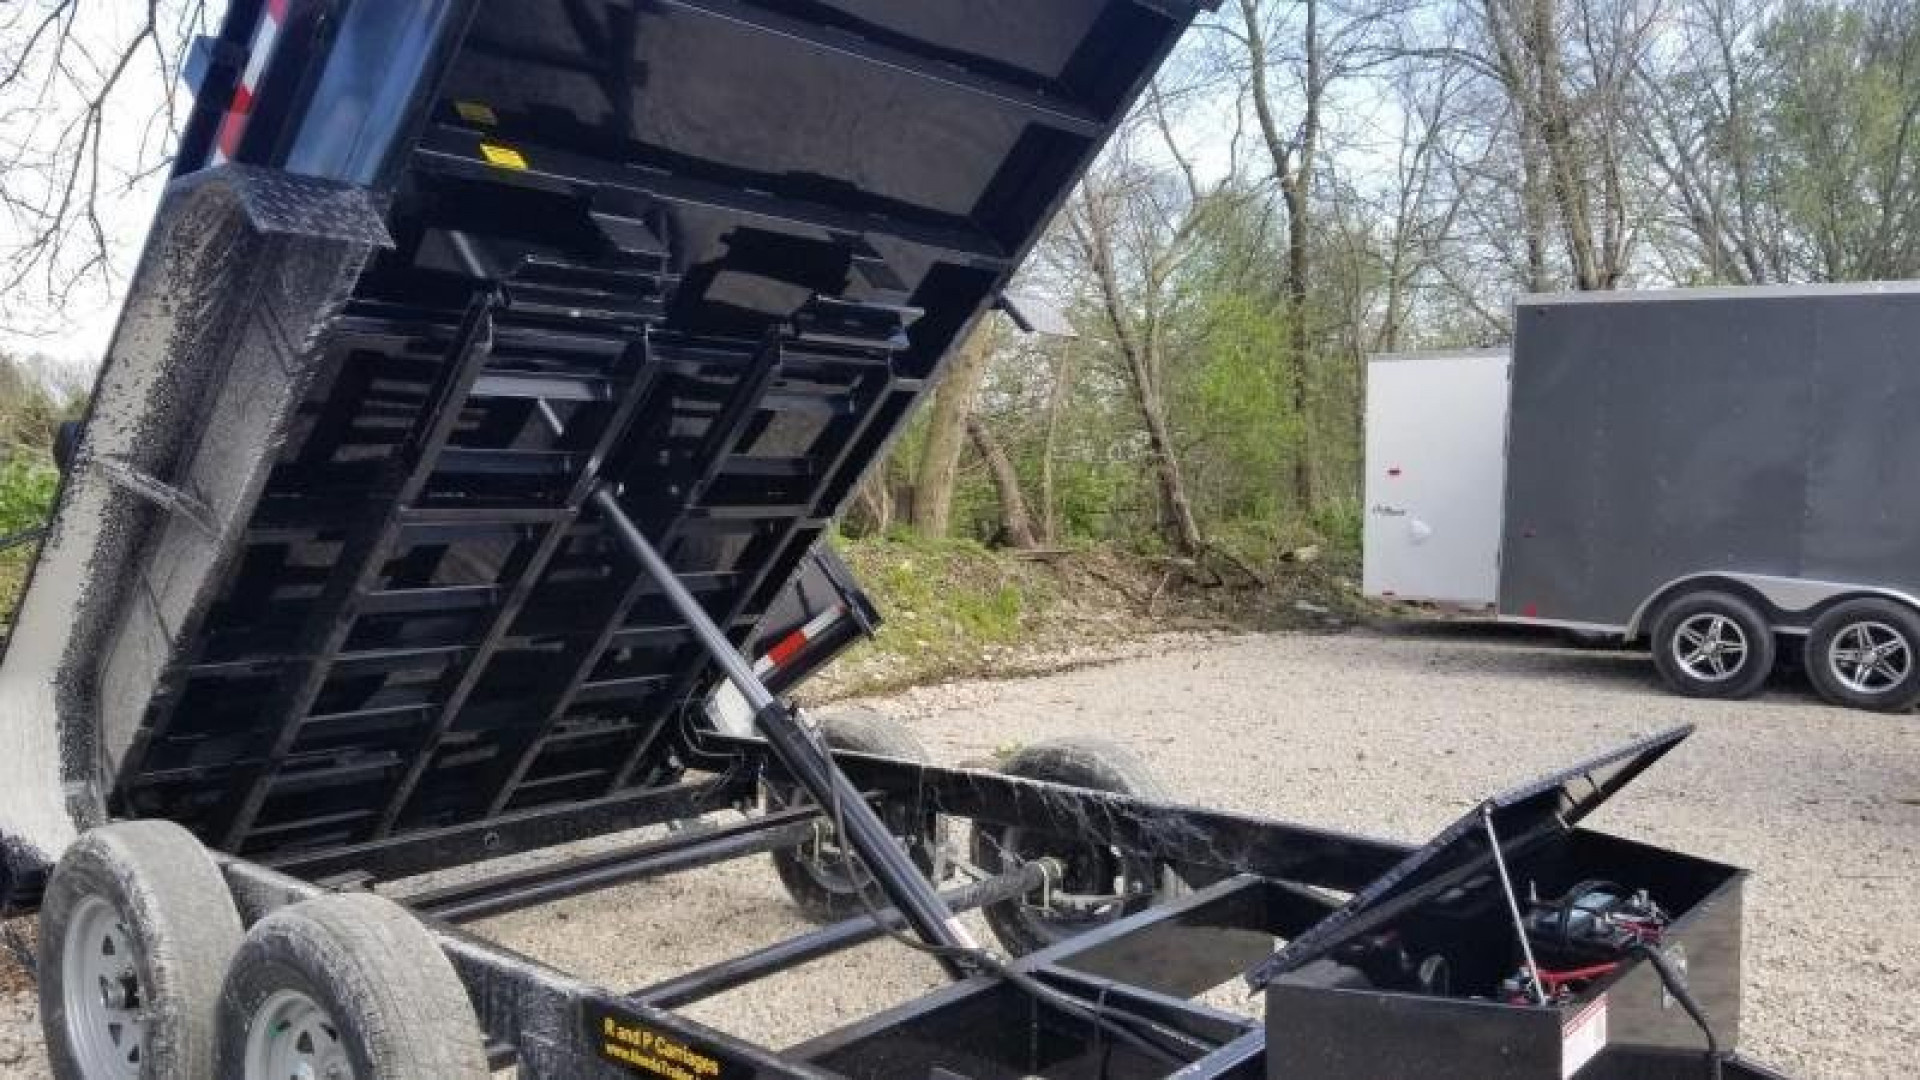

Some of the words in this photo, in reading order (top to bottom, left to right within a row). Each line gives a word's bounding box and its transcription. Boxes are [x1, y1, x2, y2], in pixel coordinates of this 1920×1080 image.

[616, 1026, 642, 1045] and
[642, 1030, 654, 1049] P
[655, 1036, 719, 1076] Carriages
